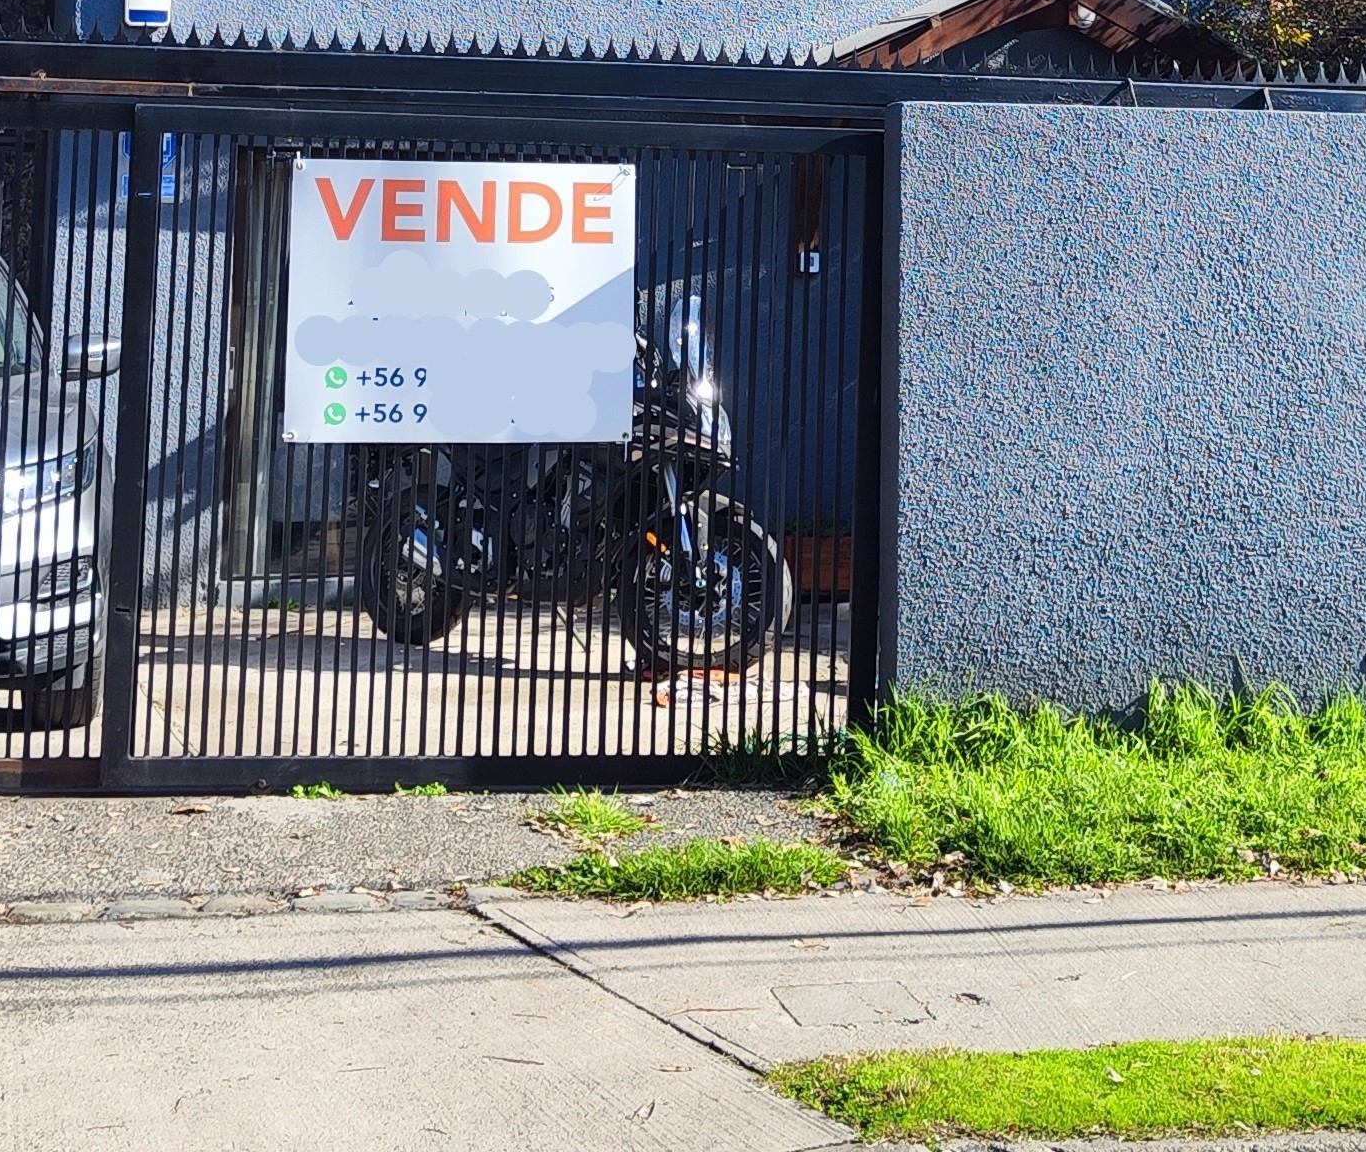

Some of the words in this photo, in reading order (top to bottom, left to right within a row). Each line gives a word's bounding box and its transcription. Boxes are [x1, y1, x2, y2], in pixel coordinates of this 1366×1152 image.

[315, 177, 614, 244] VENDE
[356, 368, 404, 388] +56
[414, 367, 427, 387] 9
[355, 403, 403, 424] +56
[413, 404, 428, 423] 9
